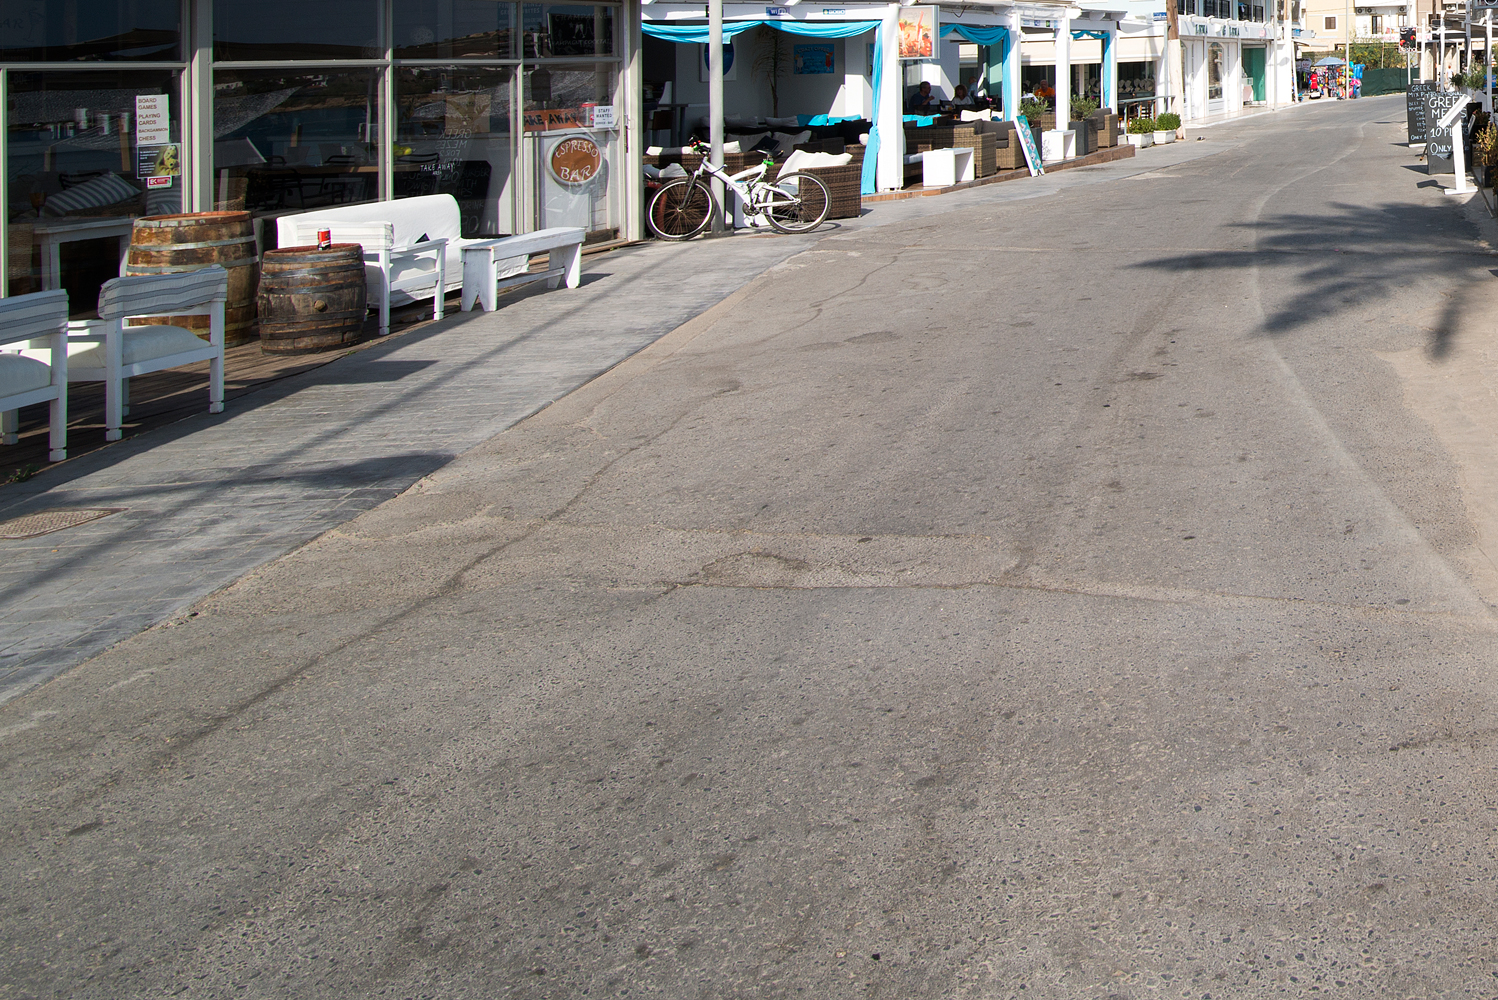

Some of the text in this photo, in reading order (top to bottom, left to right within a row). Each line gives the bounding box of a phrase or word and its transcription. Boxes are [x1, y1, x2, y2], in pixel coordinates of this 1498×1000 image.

[523, 112, 577, 127] AKE AWAY
[555, 140, 599, 158] ESPRESSO
[560, 165, 591, 181] BAR
